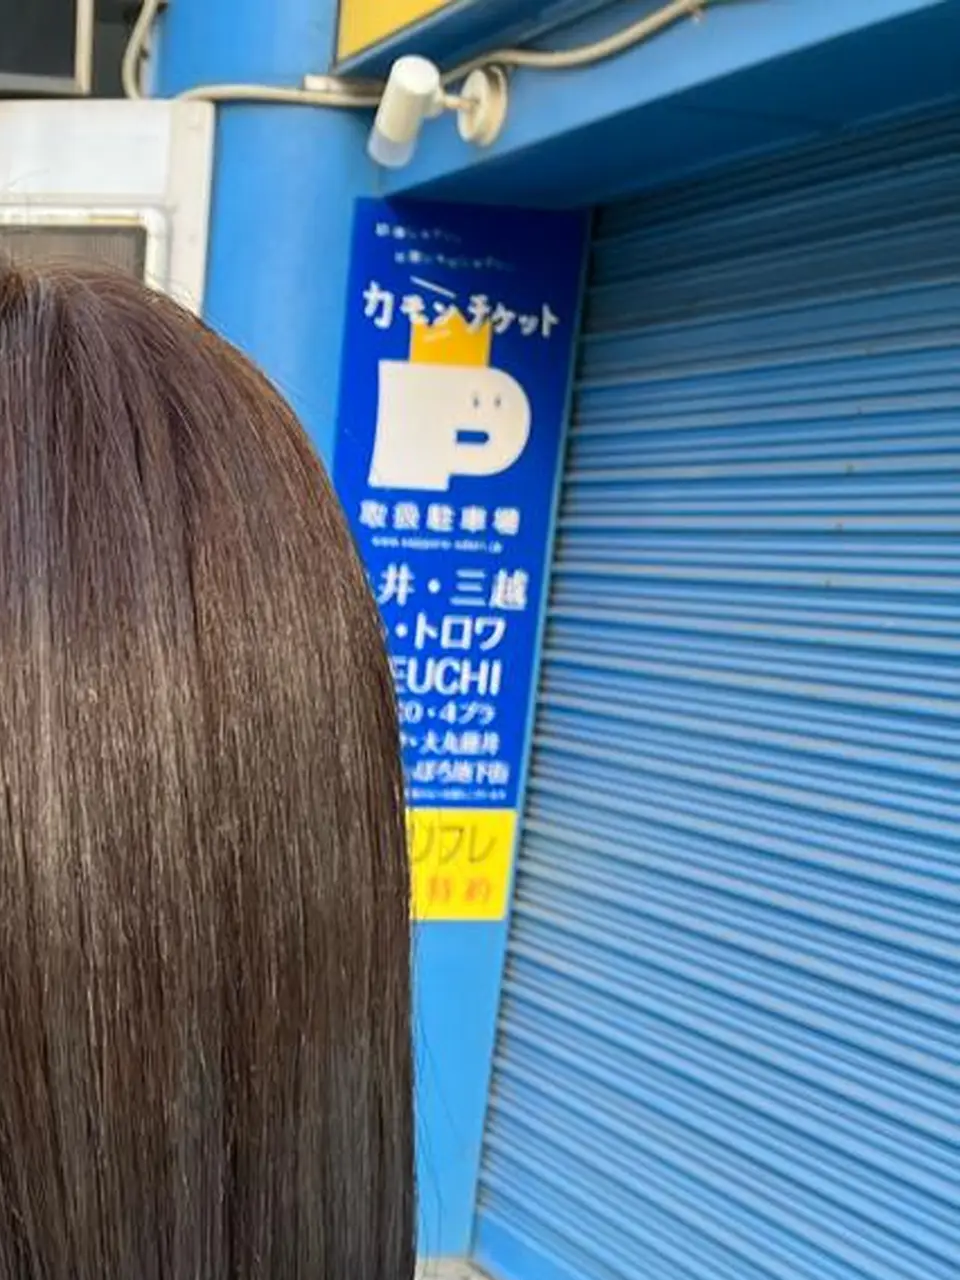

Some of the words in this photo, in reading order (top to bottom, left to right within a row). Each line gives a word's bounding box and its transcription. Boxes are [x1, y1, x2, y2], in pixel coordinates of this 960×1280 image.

[368, 561, 530, 611] 井・三越
[386, 610, 506, 651] ・トロワ
